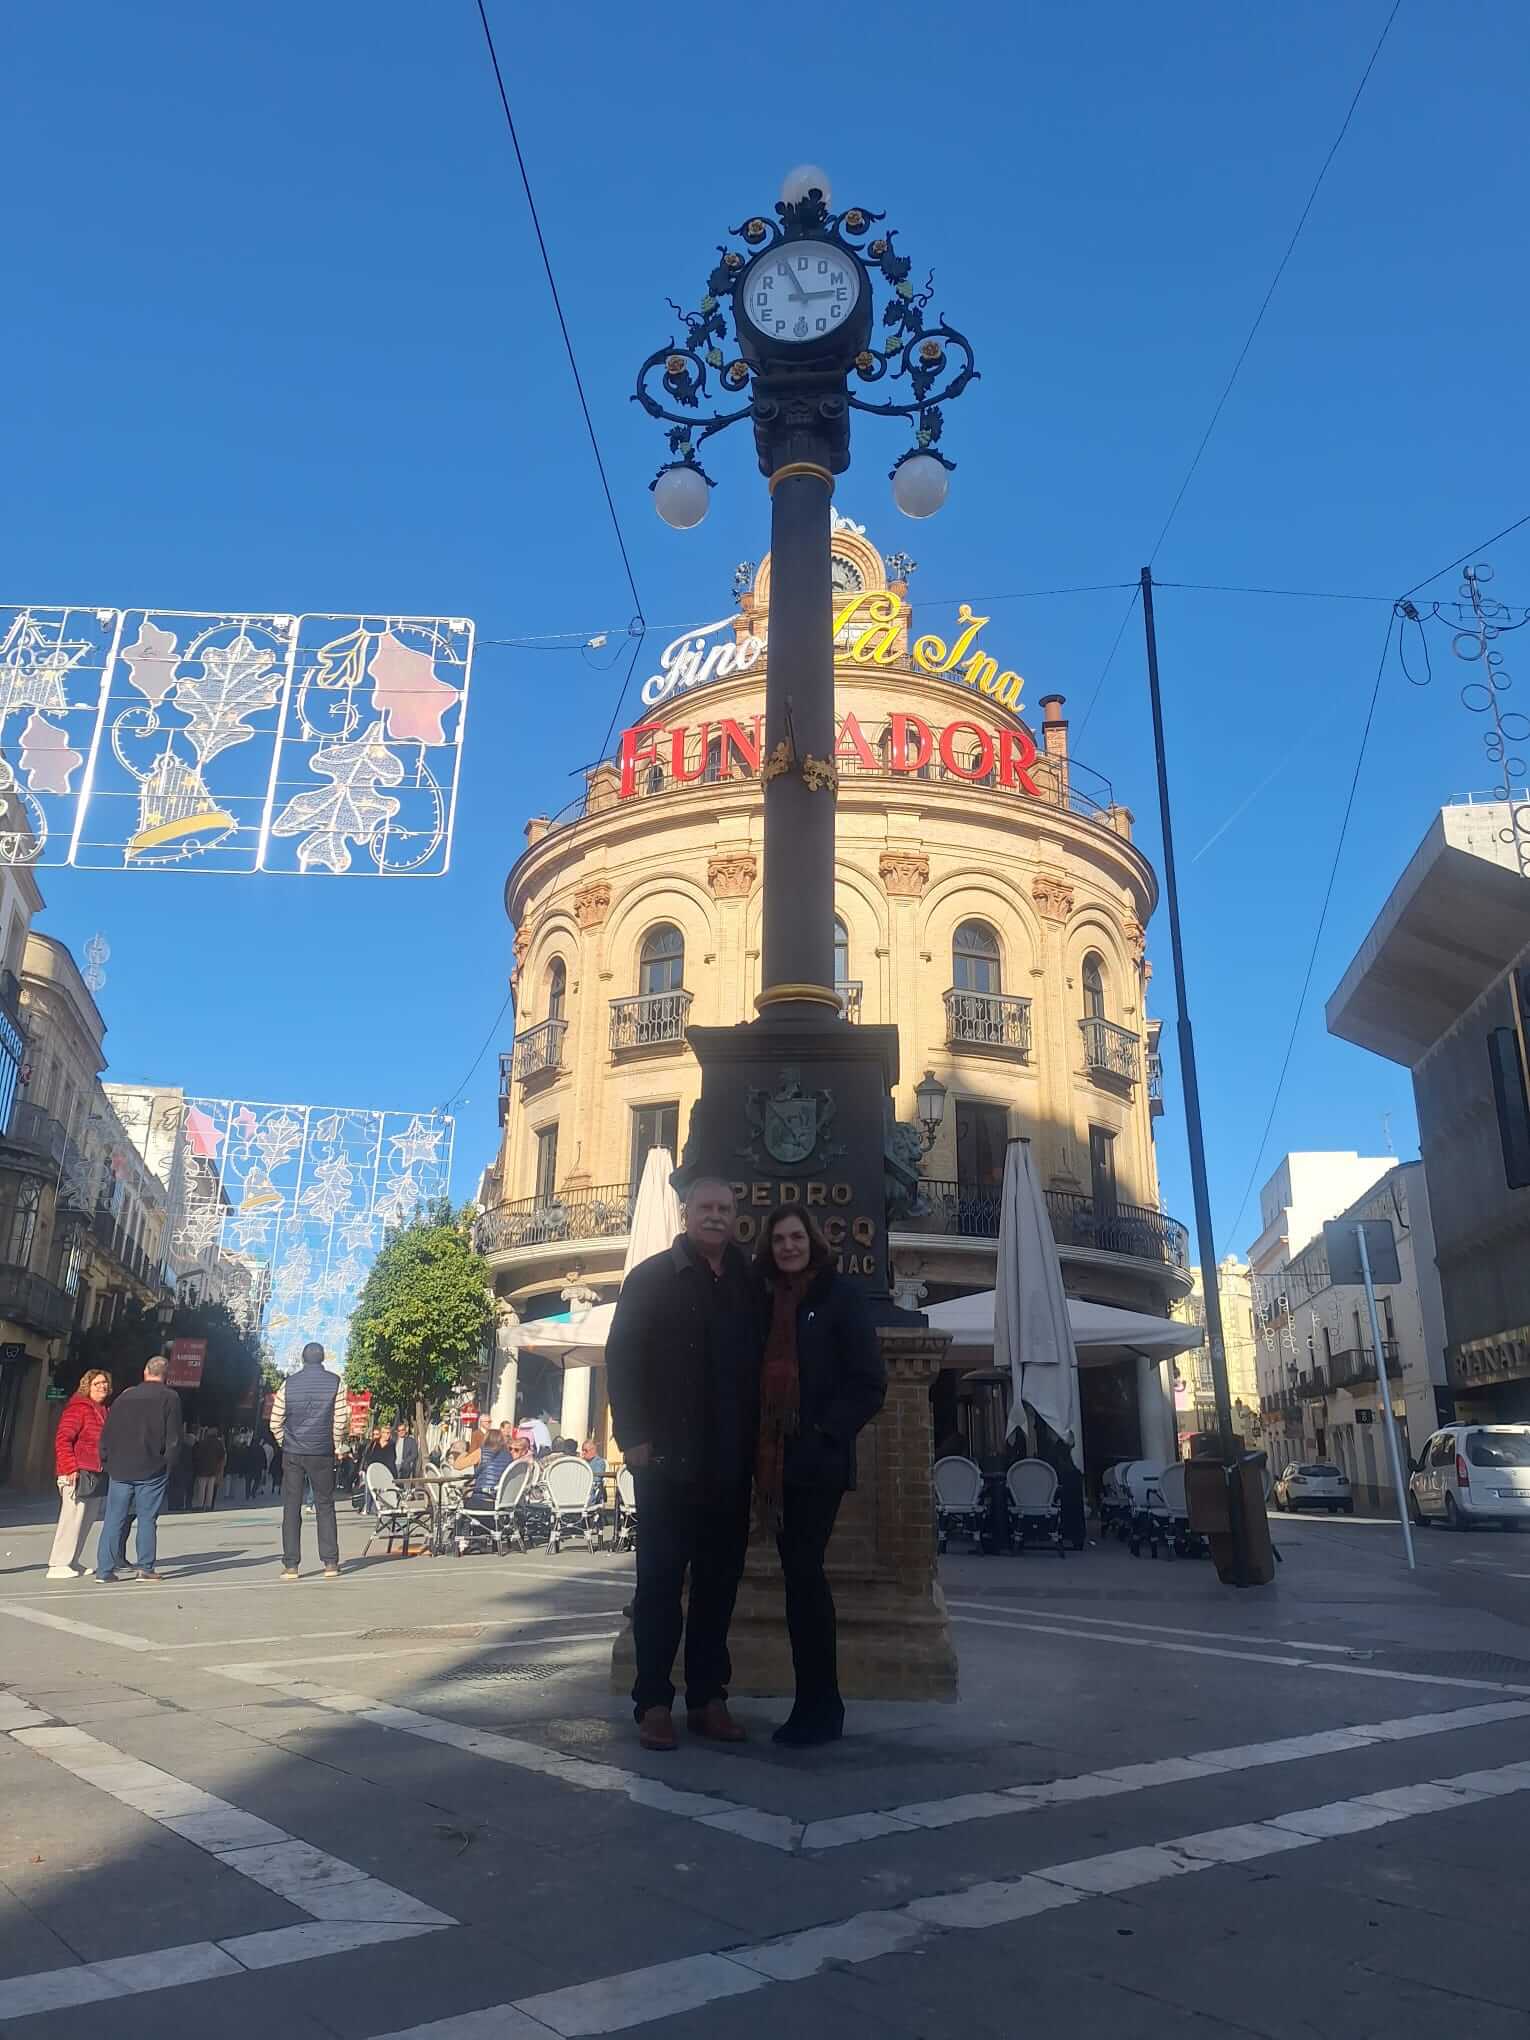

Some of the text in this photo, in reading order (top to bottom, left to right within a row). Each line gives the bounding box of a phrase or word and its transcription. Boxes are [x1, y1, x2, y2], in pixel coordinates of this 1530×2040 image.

[641, 613, 768, 706] Fino
[618, 711, 1043, 799] FUNADOR
[729, 1182, 853, 1207] PEDRO
